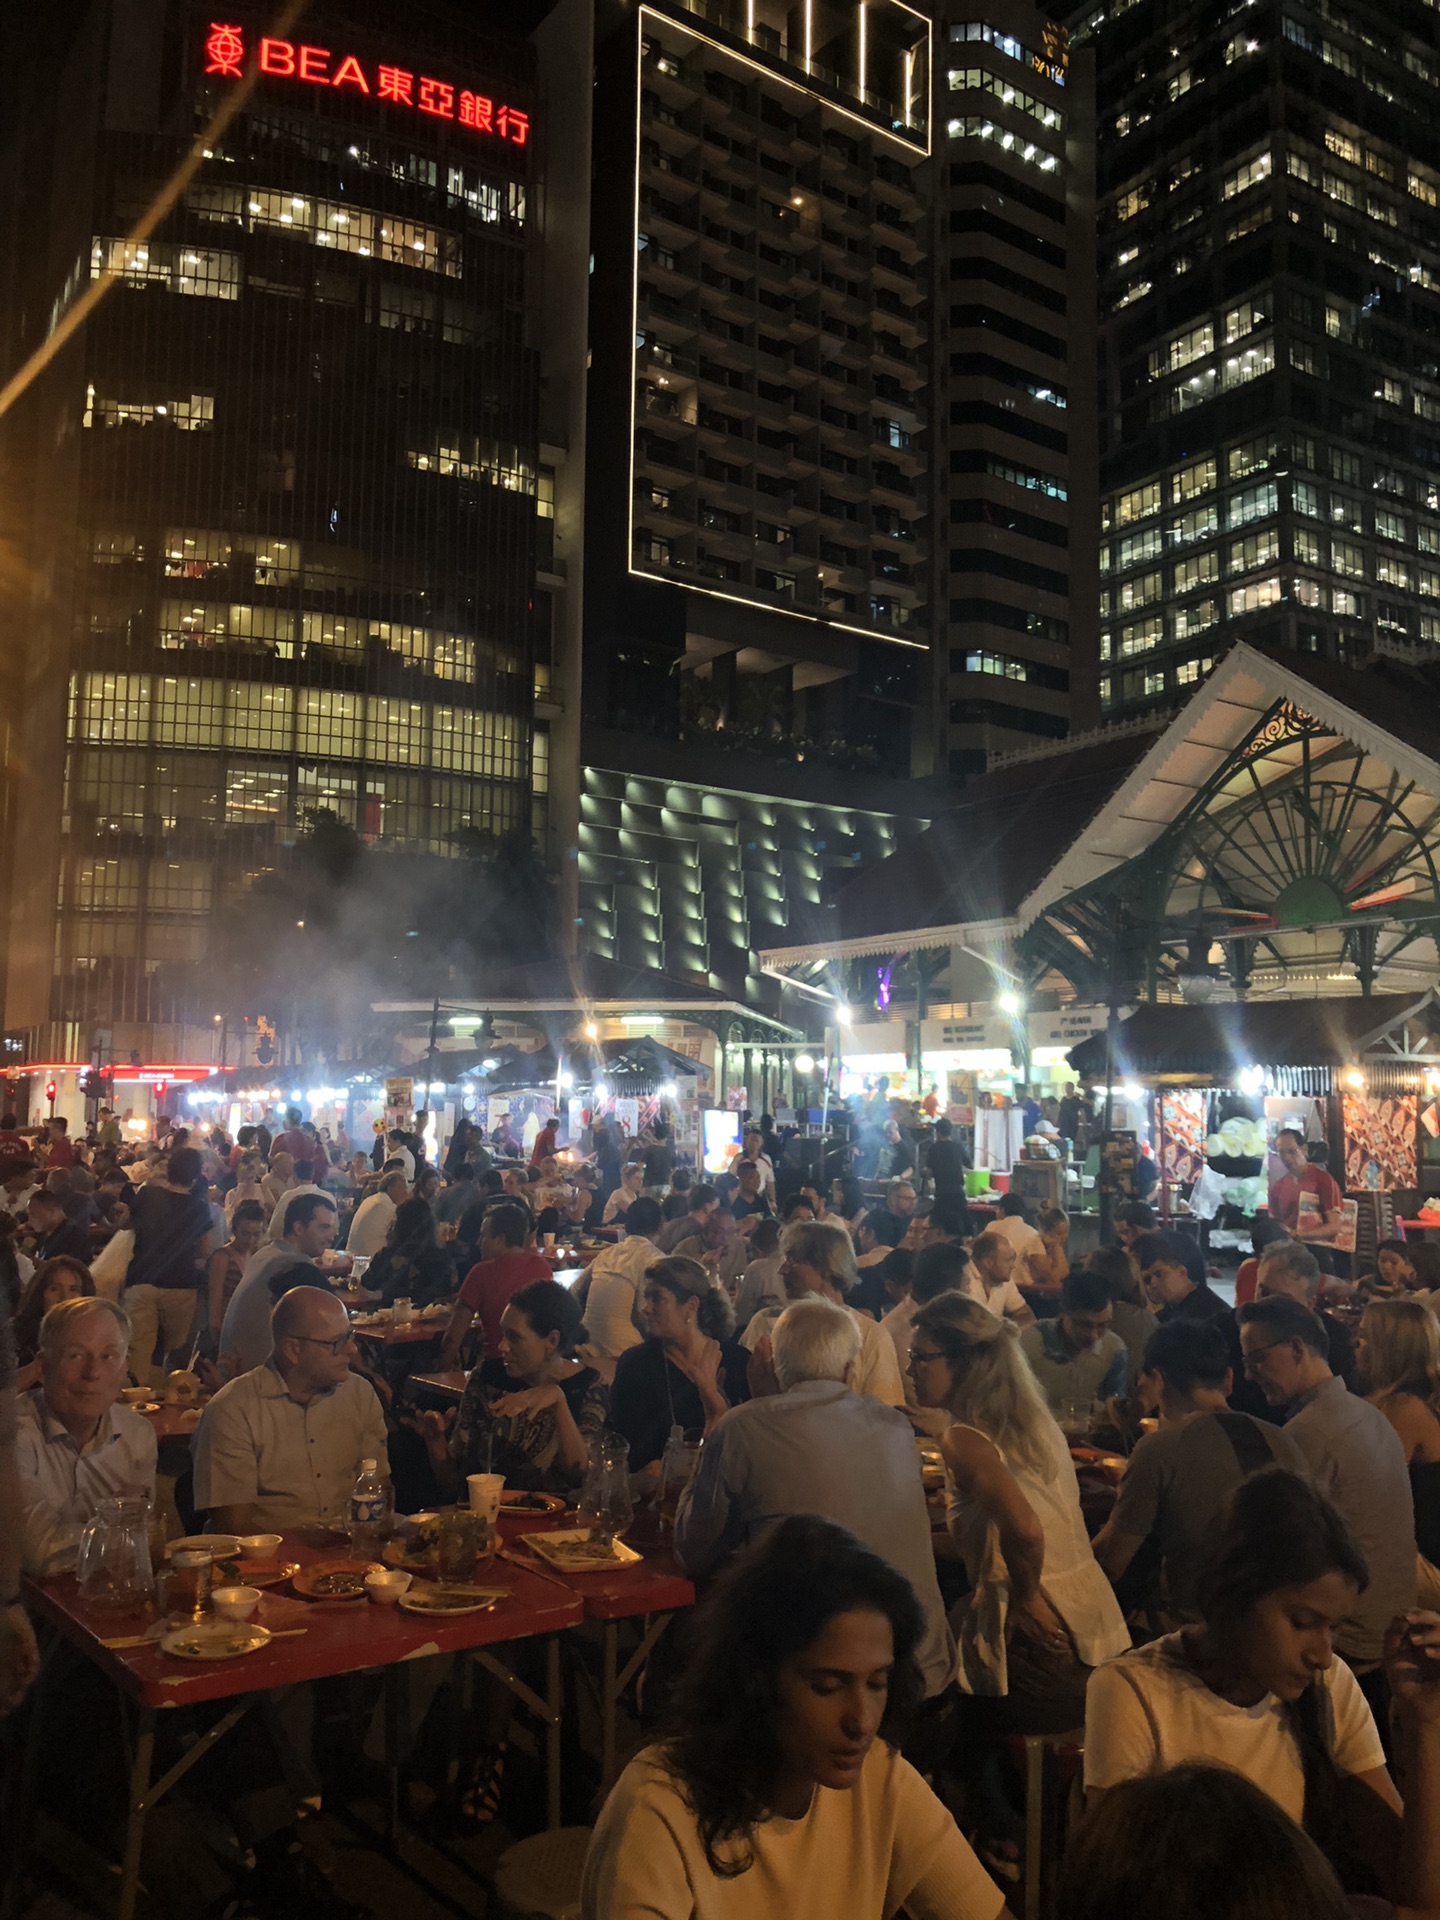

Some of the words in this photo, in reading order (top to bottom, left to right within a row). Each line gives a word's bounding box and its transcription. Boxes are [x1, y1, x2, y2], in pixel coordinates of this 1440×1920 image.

[260, 37, 370, 94] BEA
[377, 64, 529, 145] 東亞銀行
[622, 1114, 631, 1134] 8
